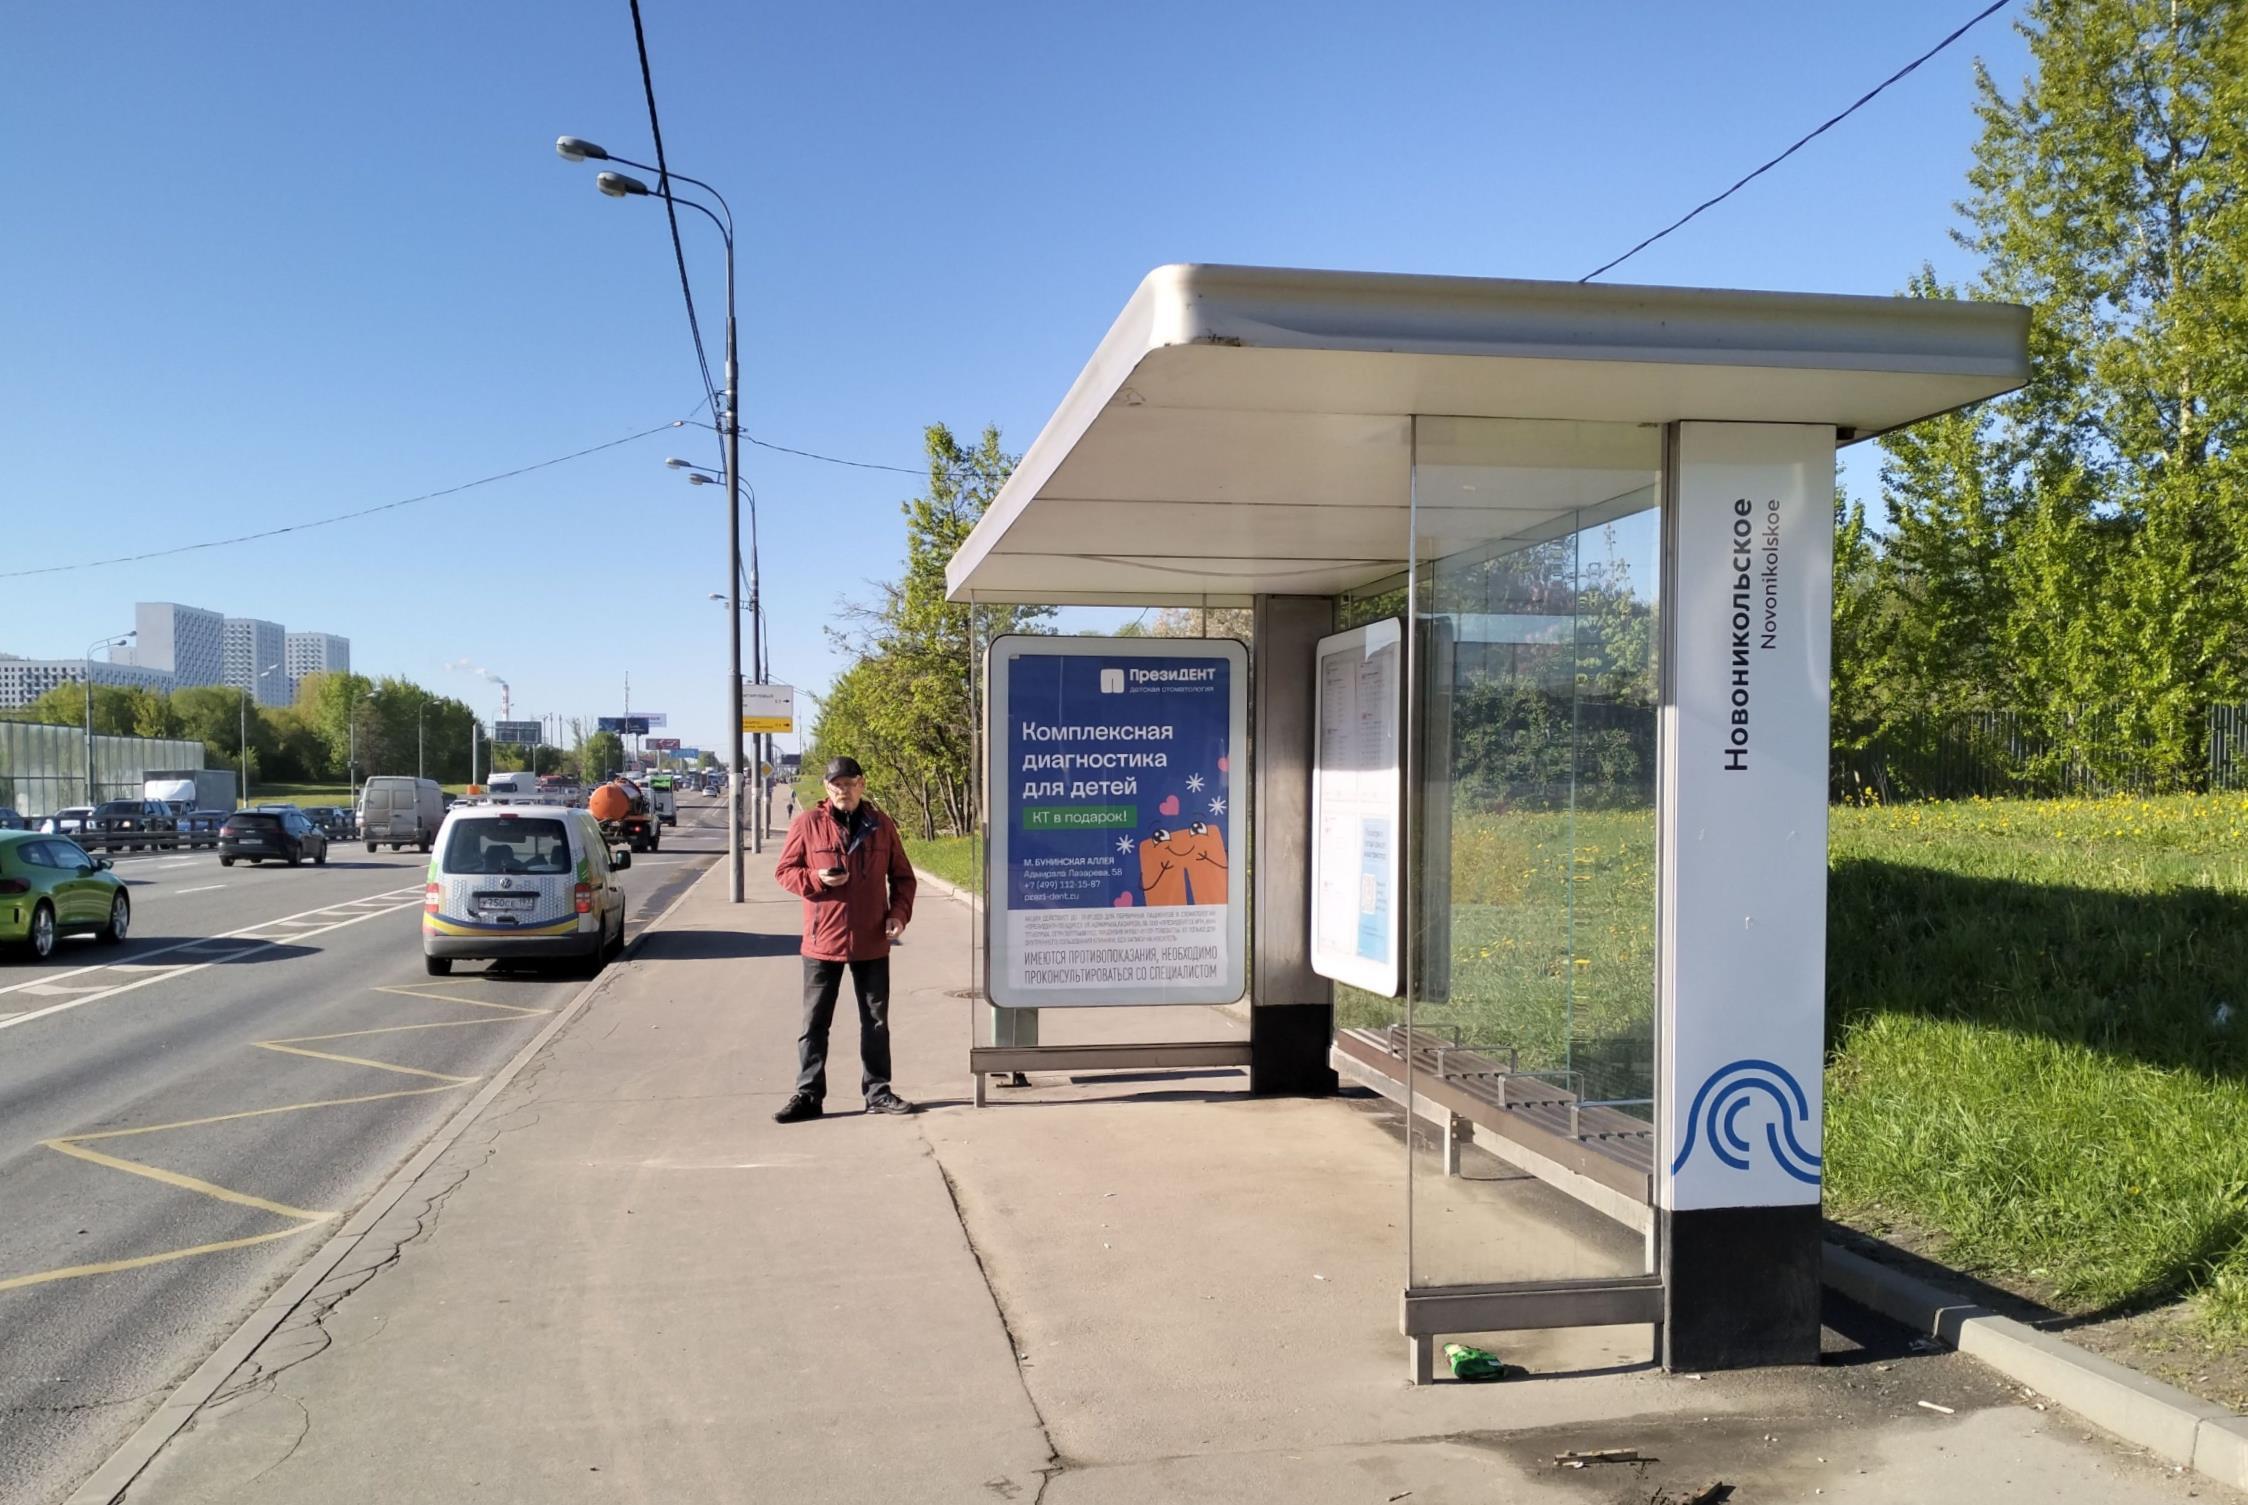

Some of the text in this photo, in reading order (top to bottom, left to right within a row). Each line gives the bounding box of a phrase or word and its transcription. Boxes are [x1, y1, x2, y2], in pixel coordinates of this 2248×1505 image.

[1761, 499, 1780, 649] Novonikolskoe
[1724, 498, 1753, 771] Новоникольское
[1022, 721, 1174, 741] Комплексная
[1022, 752, 1168, 772] диагностика
[1022, 776, 1137, 799] для детей
[1032, 810, 1127, 825] КТ в подарок!
[1035, 857, 1085, 866] БУНИНСКАЯ
[1086, 856, 1115, 865] АЛЛЕЯ
[1024, 945, 1218, 966] ИМЕЮТСЯ ПРОТИВОПОКАЗАНИЯ, НЕОБХОДИМО
[1136, 966, 1147, 981] СО
[1149, 964, 1218, 981] СПЕЦИАЛИСТОМ
